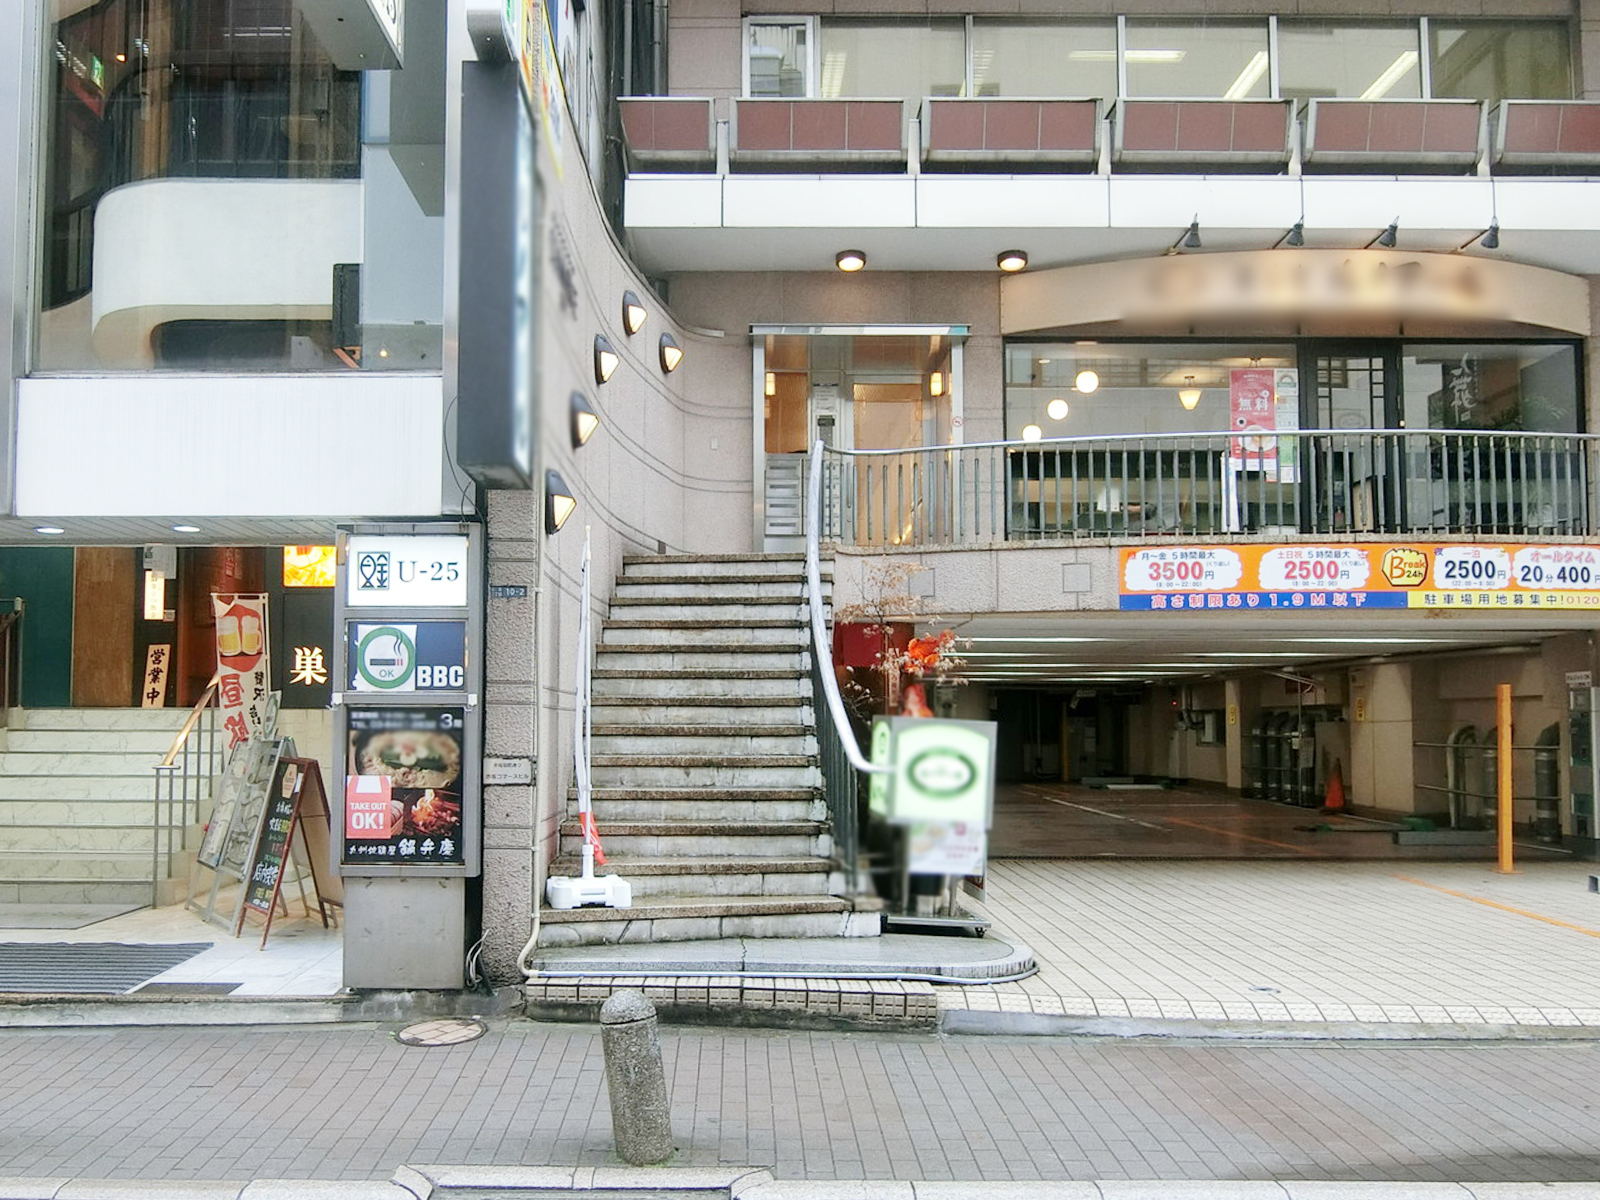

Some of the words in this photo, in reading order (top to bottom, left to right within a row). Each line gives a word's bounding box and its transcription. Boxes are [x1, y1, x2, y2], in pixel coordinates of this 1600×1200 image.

[1238, 397, 1268, 411] 無料
[1278, 550, 1303, 560] 土日祝
[1463, 550, 1481, 559] 一泊
[1530, 551, 1595, 563] オールタイム
[397, 560, 459, 582] U-25
[1390, 555, 1426, 579] Break
[1405, 570, 1424, 579] 24h
[506, 588, 525, 596] 10-2
[289, 646, 328, 686] 巣
[146, 648, 166, 706] 営業中
[379, 669, 395, 678] OK
[417, 665, 464, 687] BBC
[350, 802, 370, 811] TAKE
[371, 802, 387, 811] OUT
[351, 812, 384, 830] OK!
